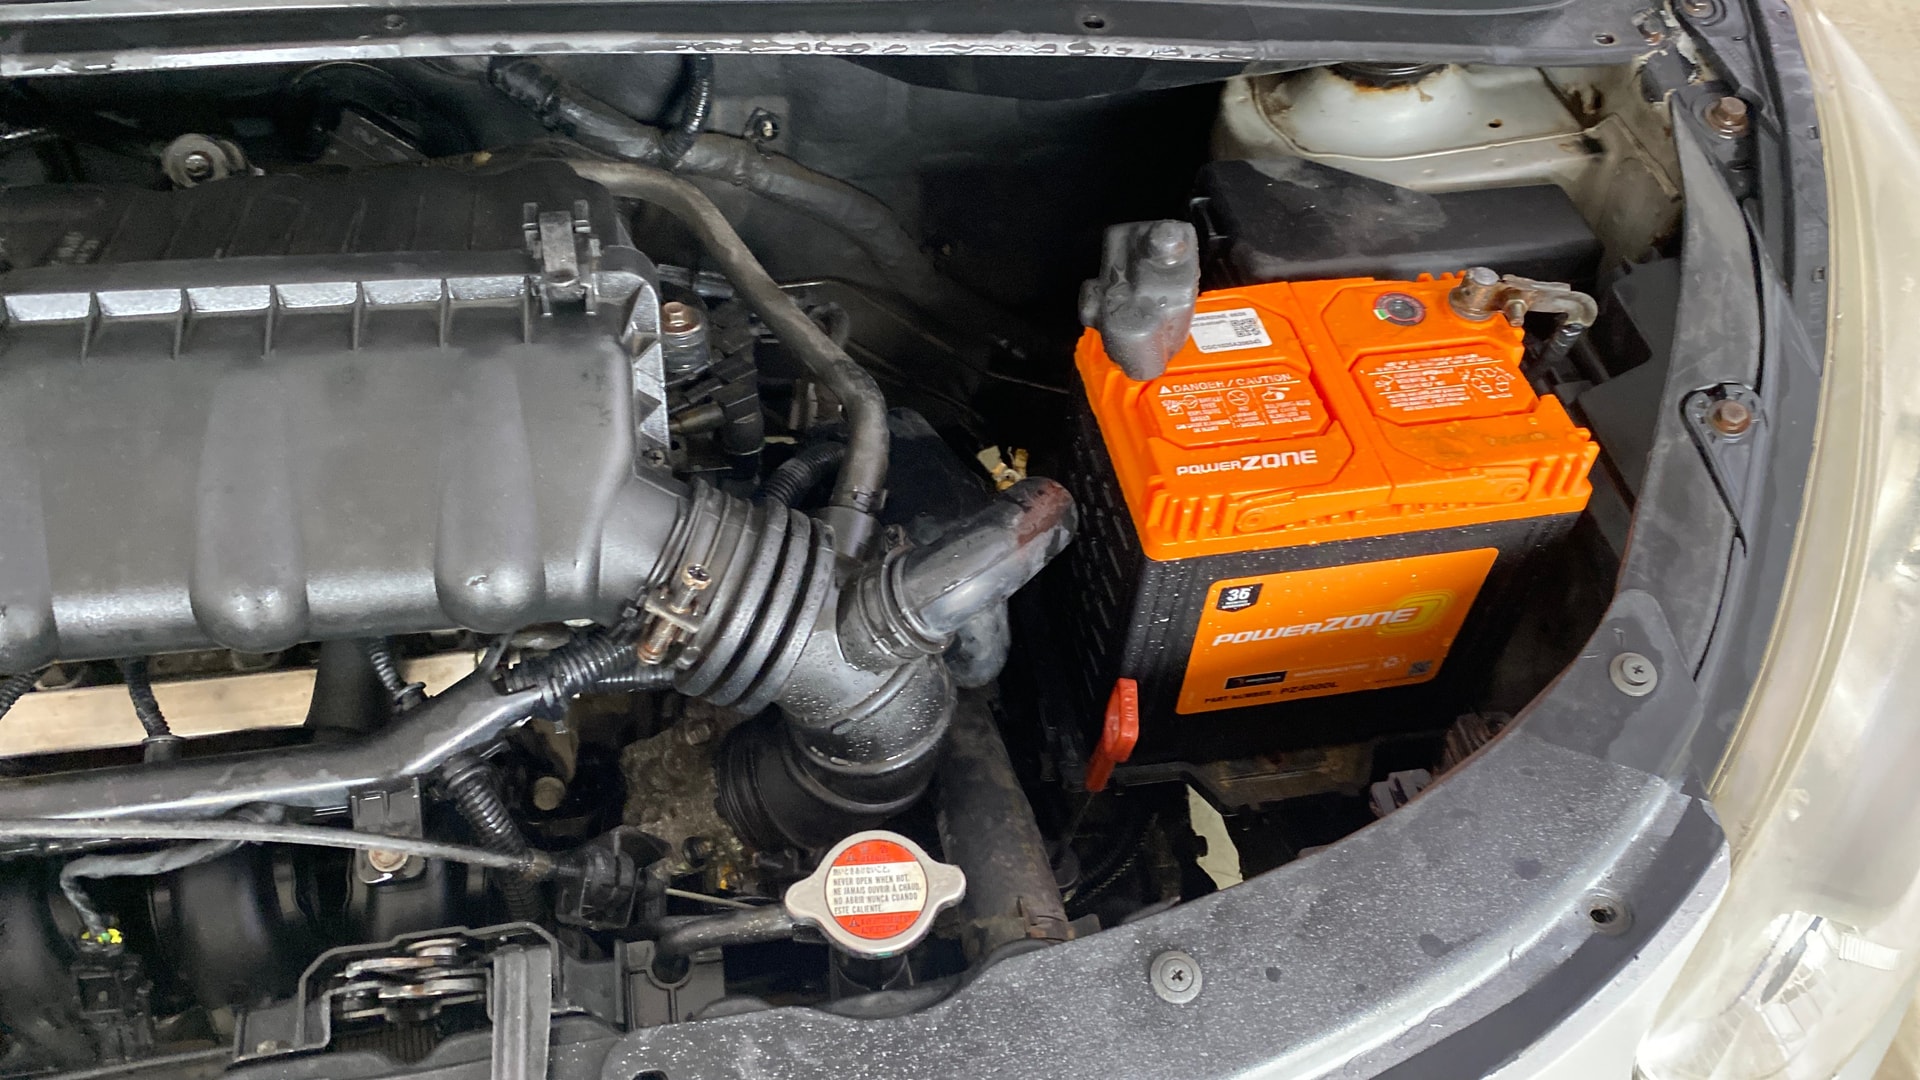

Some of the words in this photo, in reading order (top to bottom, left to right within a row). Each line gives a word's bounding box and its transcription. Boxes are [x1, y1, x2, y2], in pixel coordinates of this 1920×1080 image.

[1172, 381, 1225, 393] DANGER
[1235, 373, 1292, 386] CAUTION
[1176, 449, 1318, 476] POWERZONE
[1227, 588, 1251, 601] 36
[1212, 608, 1418, 646] POWERZONE
[833, 877, 853, 886] NEVER
[856, 876, 873, 885] OPEN
[875, 875, 894, 884] WHEN
[833, 888, 842, 896] NE
[844, 886, 866, 895] JAMAIS
[868, 885, 891, 894] OUVRIR
[833, 897, 843, 905] NO
[846, 896, 865, 905] ABRIR
[867, 895, 889, 903] NUNCA
[892, 892, 917, 901] CUANDO
[834, 906, 849, 915] ESTE
